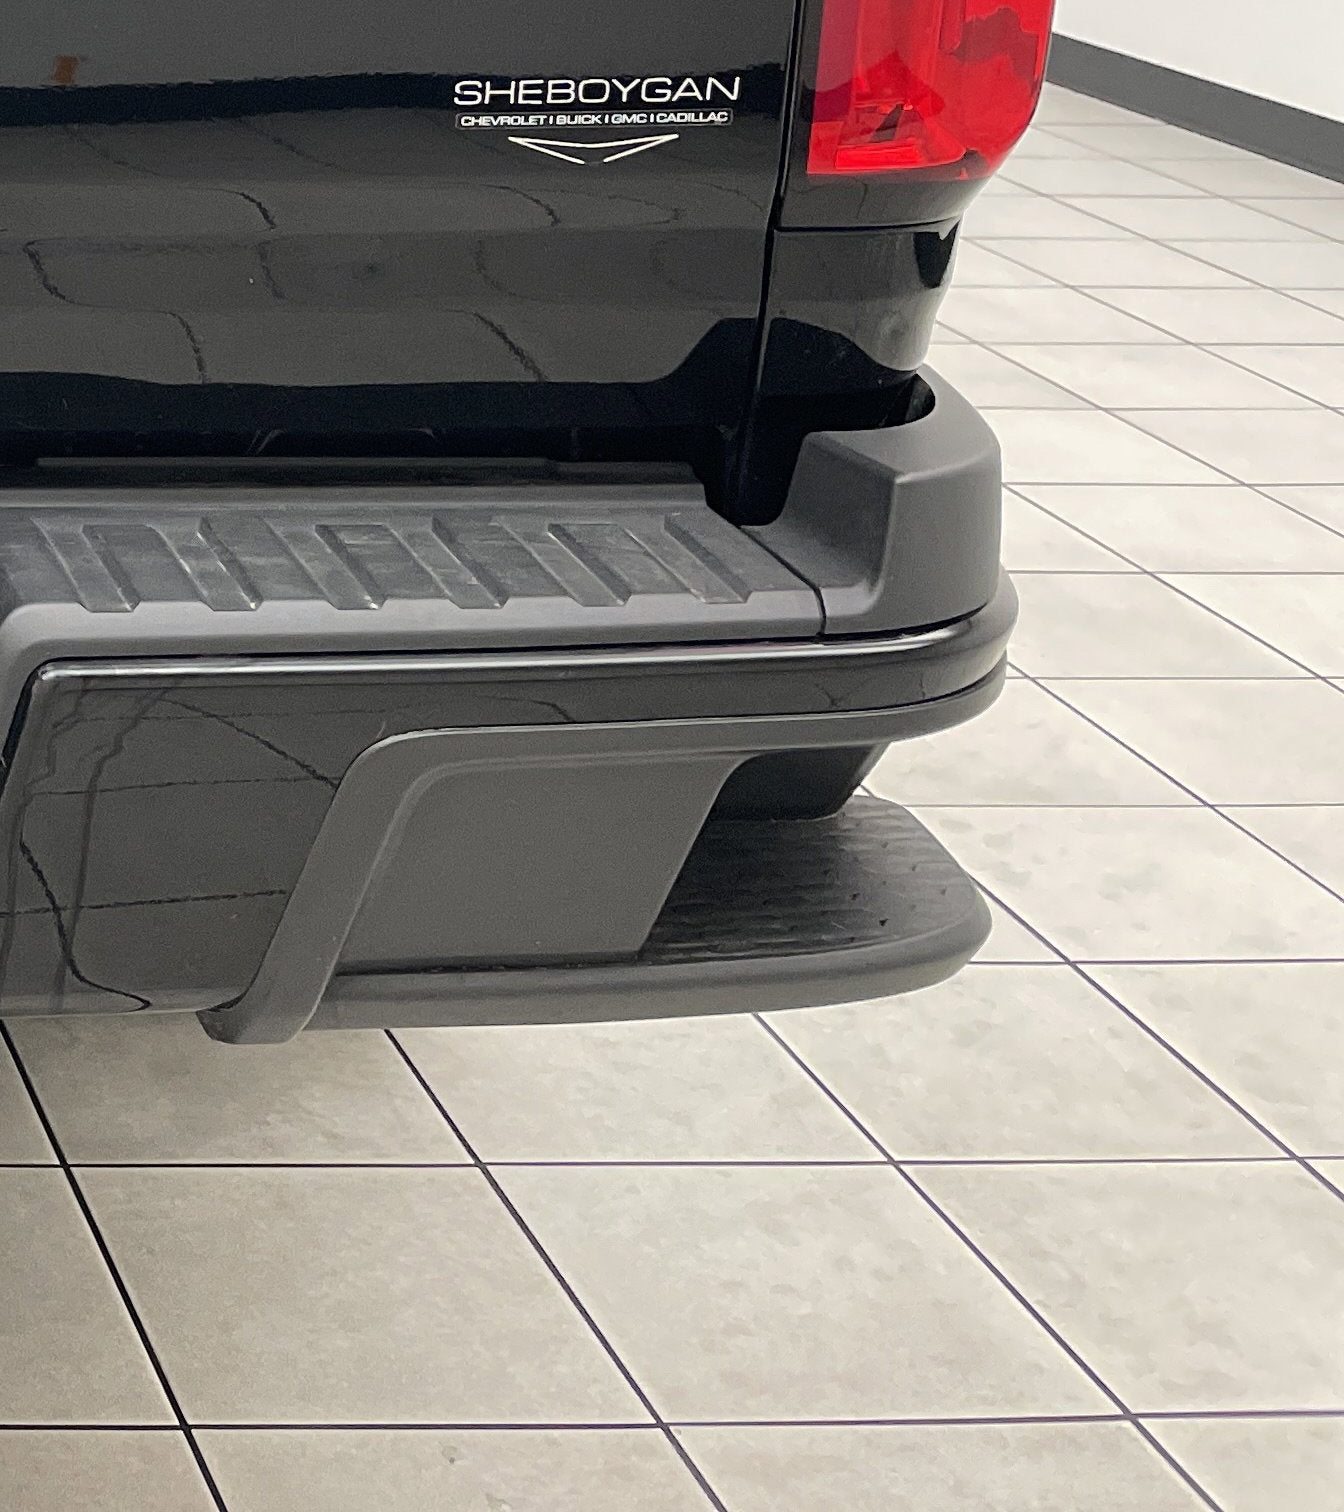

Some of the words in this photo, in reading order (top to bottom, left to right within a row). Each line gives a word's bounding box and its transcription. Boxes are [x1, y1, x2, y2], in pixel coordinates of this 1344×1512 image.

[453, 76, 741, 106] SHEBOYGAN
[460, 114, 549, 127] CHEVROLET
[556, 114, 604, 126] BUICK
[610, 113, 649, 126] GMC
[655, 111, 730, 125] CADILLAC
